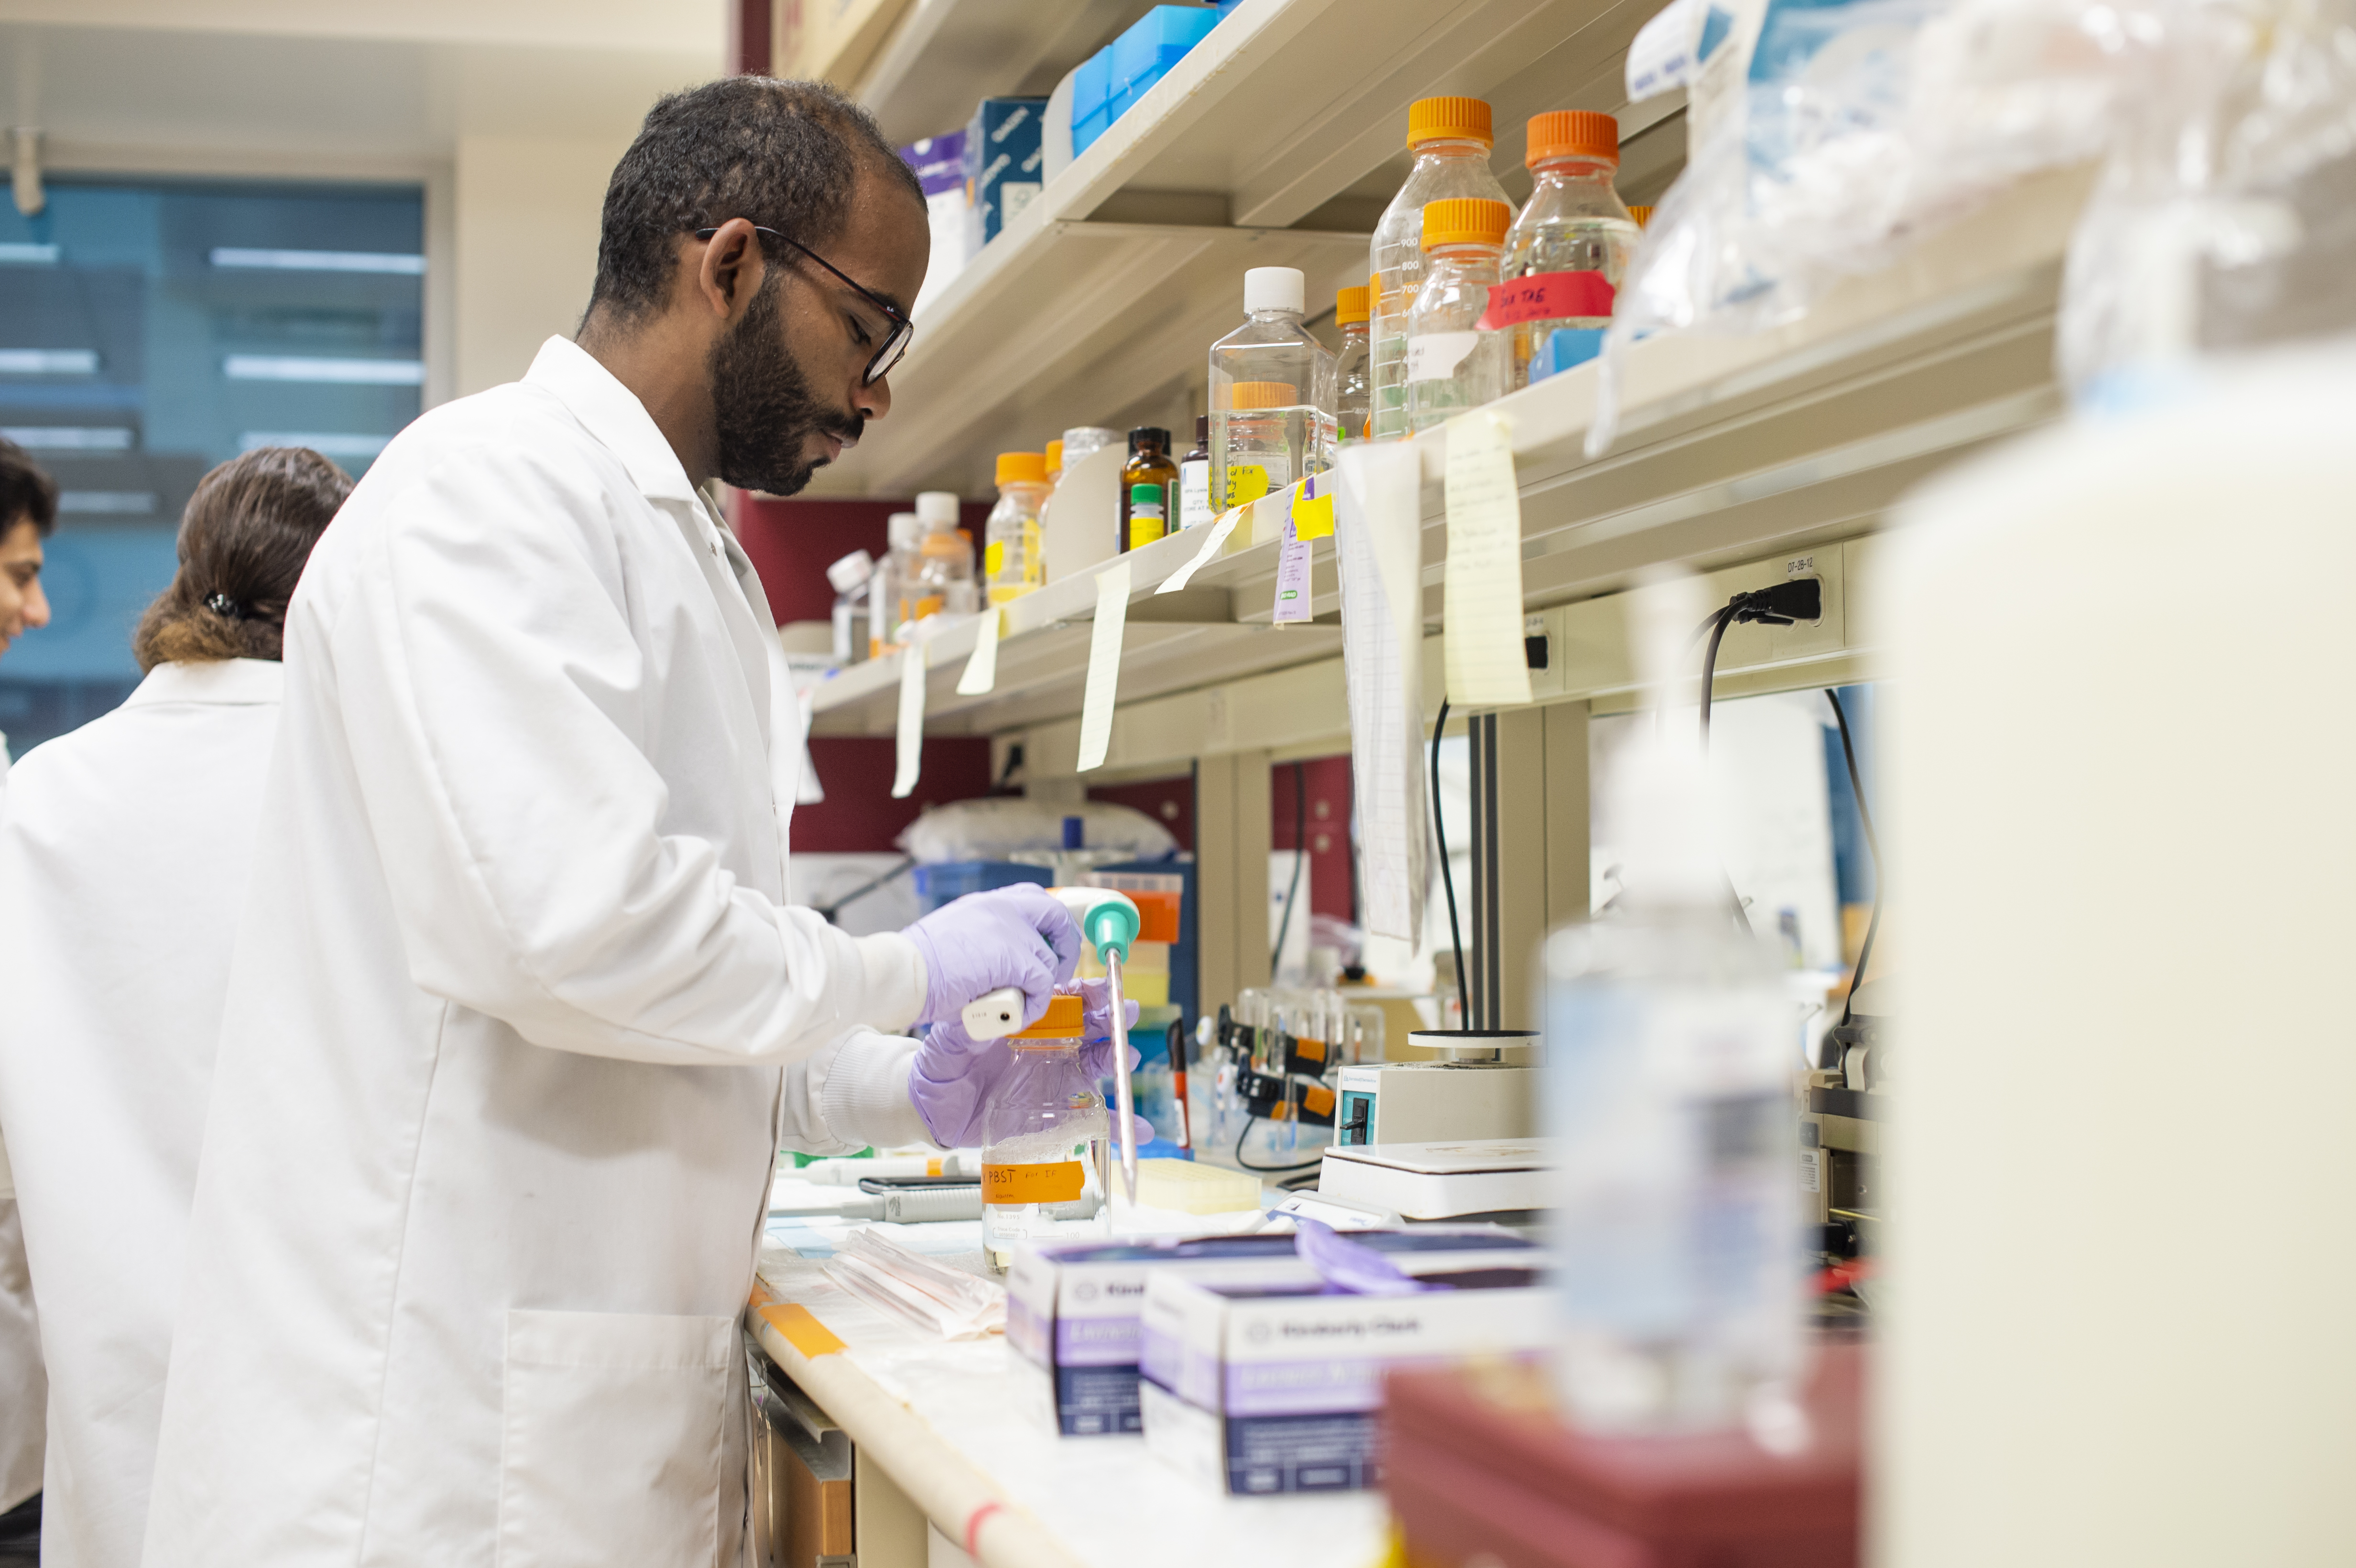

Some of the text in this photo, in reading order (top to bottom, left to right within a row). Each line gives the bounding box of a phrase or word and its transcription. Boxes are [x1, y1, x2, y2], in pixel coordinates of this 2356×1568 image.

[1401, 237, 1418, 248] 900
[1402, 261, 1419, 271] 800
[1402, 284, 1419, 294] 700
[989, 1169, 1016, 1185] PBST
